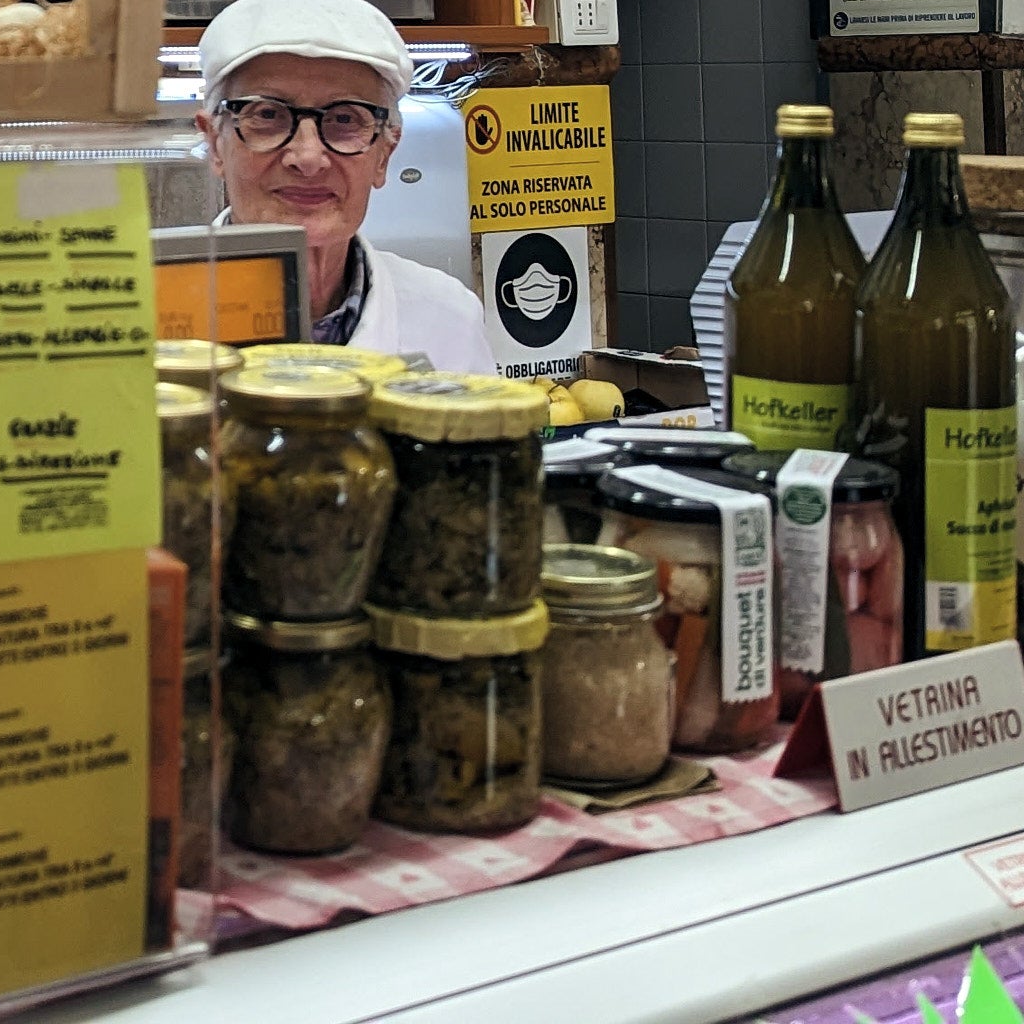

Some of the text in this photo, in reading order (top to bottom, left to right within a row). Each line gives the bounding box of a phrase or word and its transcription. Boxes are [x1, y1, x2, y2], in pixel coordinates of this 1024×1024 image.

[530, 102, 579, 125] LIMITE
[506, 127, 606, 153] INVALICABILE
[482, 175, 592, 196] ZONA RISERVATA
[470, 197, 606, 220] AL SOLO PERSONALE
[744, 395, 838, 423] Hofkeller
[735, 592, 753, 691] bouquet
[878, 675, 981, 727] VETRINA
[846, 708, 1022, 781] IN ALLESTIMENTO
